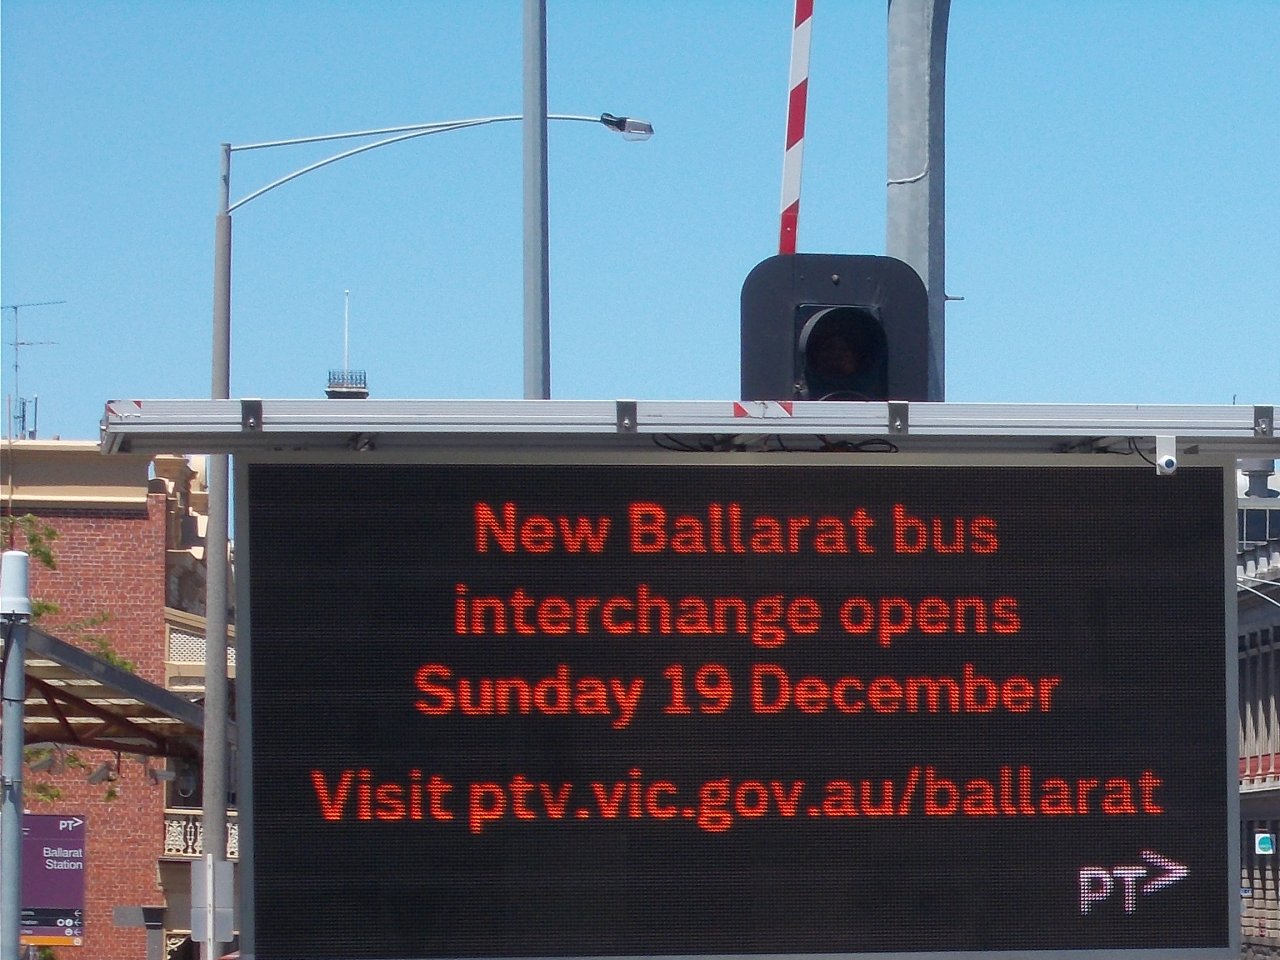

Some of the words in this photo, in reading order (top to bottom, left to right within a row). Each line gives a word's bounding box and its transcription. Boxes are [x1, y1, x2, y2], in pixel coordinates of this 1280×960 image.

[474, 501, 612, 553] New
[628, 501, 875, 553] Ballarat
[893, 502, 1000, 553] bus
[454, 583, 821, 648] interchange
[839, 596, 1021, 648] opens
[414, 663, 645, 729] Sunday
[661, 663, 733, 714] 19
[751, 662, 1061, 714] December
[310, 769, 453, 821] Visit
[468, 765, 1164, 833] ptv.vic.gov.au/ballarat
[43, 847, 83, 858] Ballarat
[45, 859, 83, 870] Station
